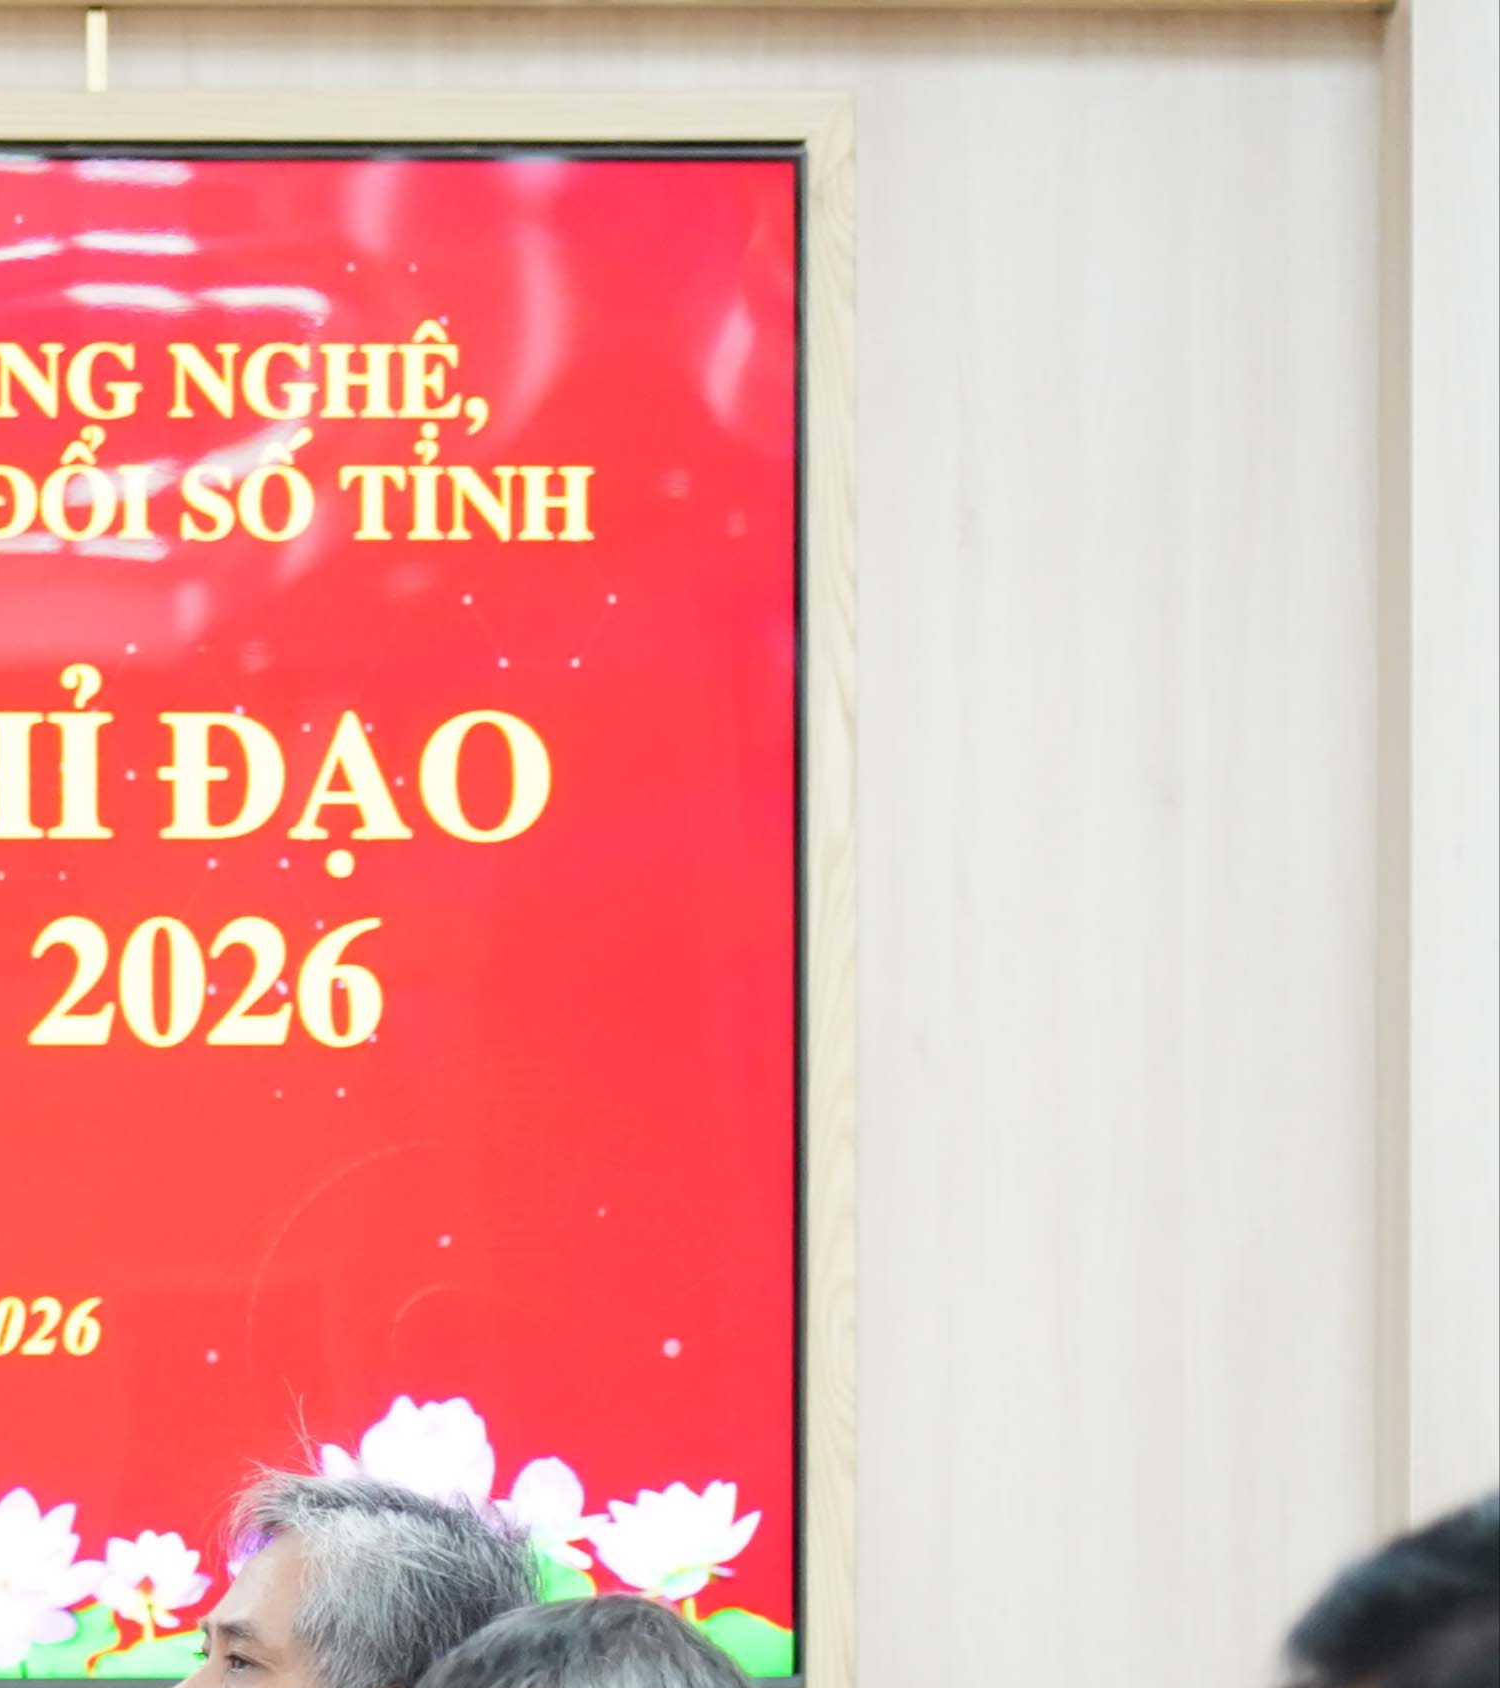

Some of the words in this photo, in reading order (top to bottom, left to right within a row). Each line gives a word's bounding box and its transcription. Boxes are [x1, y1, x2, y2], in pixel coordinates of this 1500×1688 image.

[168, 319, 489, 439] NGHỆ,
[180, 428, 315, 541] SỐ
[339, 440, 594, 541] TỈNH
[157, 711, 551, 877] ĐẠO
[28, 916, 383, 1047] 2026
